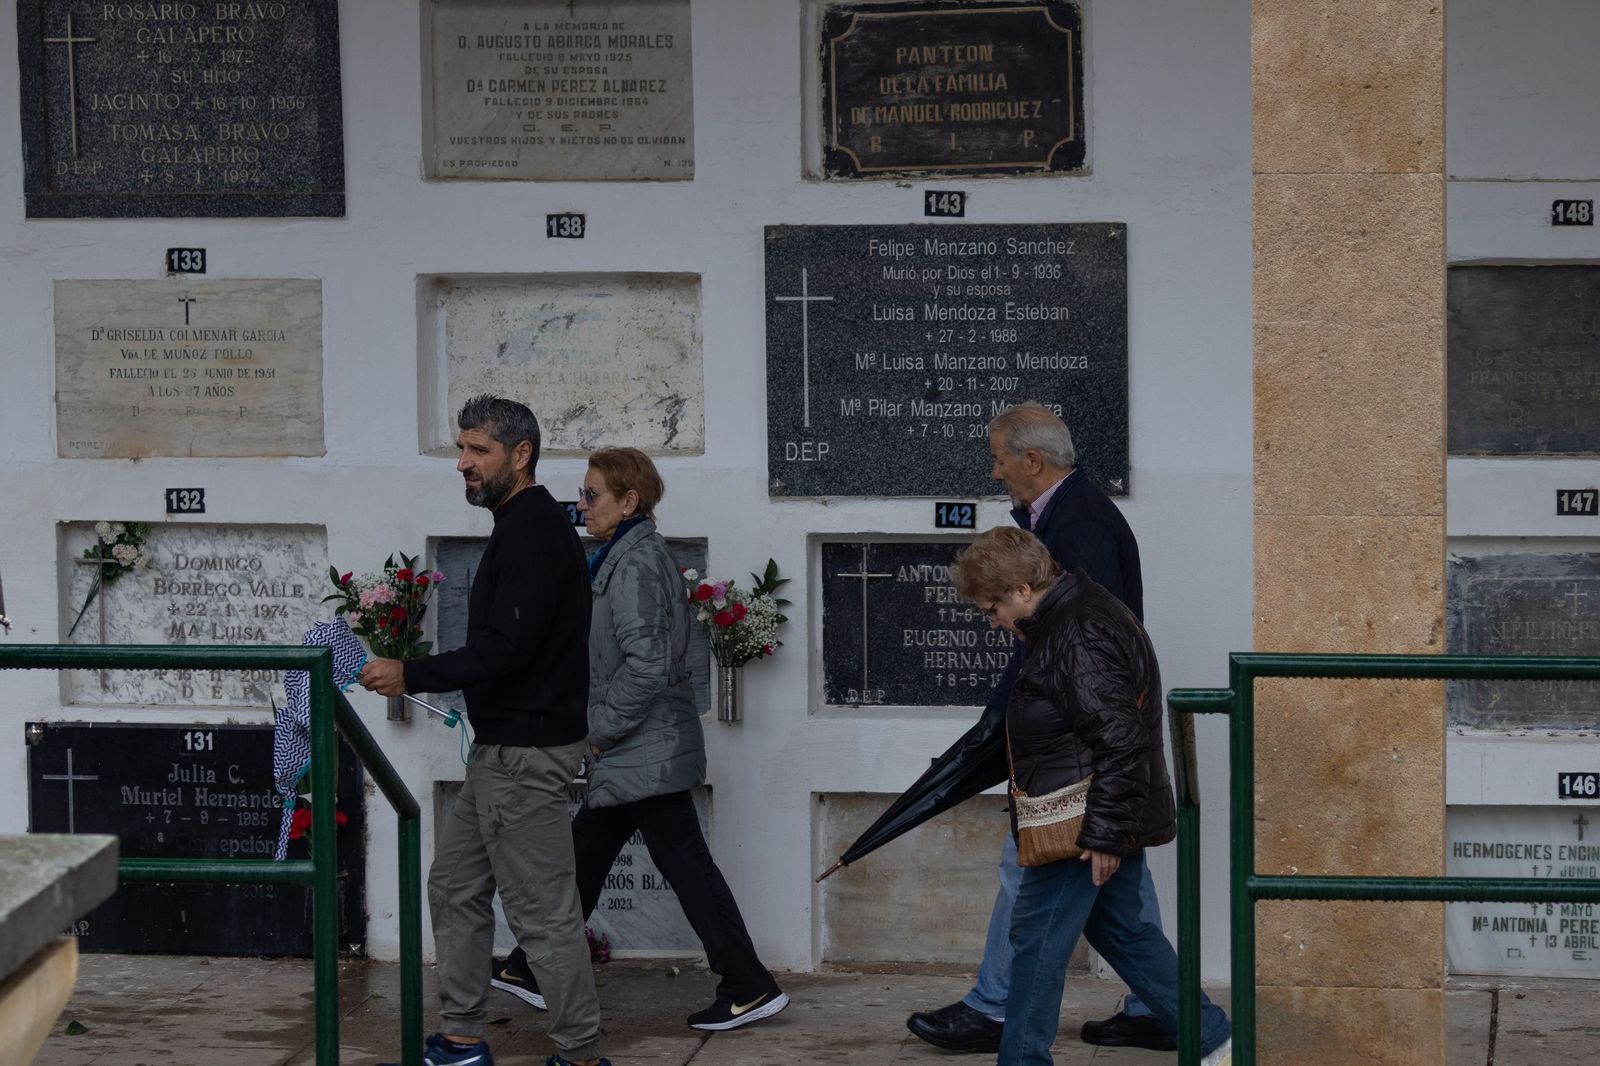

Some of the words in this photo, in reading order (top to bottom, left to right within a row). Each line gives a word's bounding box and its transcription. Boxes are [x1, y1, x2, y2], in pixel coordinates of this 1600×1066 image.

[103, 3, 196, 21] ROSARIO
[216, 3, 286, 20] BRAVO
[523, 22, 530, 31] A
[534, 22, 550, 31] LA
[554, 22, 609, 31] MEMORIA
[611, 22, 625, 31] DE
[136, 27, 255, 44] GALAPERO
[458, 35, 471, 49] D.
[477, 35, 541, 49] AUGUSTO
[548, 35, 602, 49] ABARCA
[608, 34, 674, 49] MORALES
[499, 52, 554, 62] FALLECIO
[570, 53, 601, 62] MAYO
[605, 52, 632, 62] 1925
[896, 44, 993, 65] PANTEON
[172, 70, 194, 84] SU
[203, 70, 241, 84] HIJO
[524, 66, 540, 75] DE
[544, 66, 559, 75] SU
[563, 66, 609, 75] ESPOSA
[488, 79, 546, 93] CARMEN
[552, 79, 597, 93] PEREZ
[603, 79, 667, 93] ALVAREZ
[879, 76, 903, 95] DE
[906, 75, 929, 94] LA
[934, 73, 1009, 93] FAMILIA
[91, 94, 180, 111] JACINTO
[484, 97, 541, 106] FALLECIO
[545, 97, 553, 106] 9
[557, 97, 618, 106] DICIEMBRE
[622, 97, 649, 106] 1964
[516, 110, 522, 120] Y
[528, 110, 543, 120] DE
[547, 110, 569, 120] SUS
[574, 110, 619, 120] PADRES
[875, 103, 944, 124] MANUEL
[950, 100, 1043, 122] RODRIGUEZ
[110, 124, 199, 141] TOMASA
[218, 124, 290, 141] BRAVO
[449, 136, 507, 145] VUESTROS
[511, 136, 544, 145] HIJOS
[549, 136, 555, 145] Y
[560, 136, 601, 145] NIETOS
[604, 136, 617, 145] NO
[620, 136, 634, 145] OS
[637, 136, 686, 145] OLVIDAN
[140, 147, 260, 164] GALAPERO
[459, 159, 518, 168] PROPIEDAD
[928, 193, 961, 214] 143
[1556, 202, 1590, 222] 148
[549, 217, 582, 236] 138
[868, 239, 915, 260] Felipe
[925, 238, 997, 256] Manzano
[1007, 237, 1075, 255] Sanchez
[170, 251, 202, 271] 133
[882, 264, 917, 280] Murió
[922, 268, 941, 282] por
[948, 265, 975, 280] Dios
[1033, 264, 1061, 279] 1936
[932, 285, 940, 298] y
[946, 285, 961, 296] su
[966, 284, 1012, 299] esposa
[873, 304, 914, 321] Luisa
[924, 304, 997, 321] Mendoza
[1005, 302, 1069, 321] Esteban
[107, 329, 164, 342] GRISELDA
[169, 329, 237, 342] COLMENAR
[242, 329, 286, 342] GARCIA
[938, 329, 954, 343] 27
[990, 329, 1017, 343] 1988
[143, 349, 157, 360] DE
[163, 344, 207, 360] MUÑOZ
[214, 349, 253, 360] POLLO
[855, 353, 876, 370] Mª
[882, 353, 924, 370] Luisa
[934, 353, 1006, 370] Manzano
[1016, 352, 1088, 369] Mendoza
[109, 367, 159, 379] FALLECIO
[163, 368, 177, 379] EL
[202, 367, 233, 379] JUNIO
[237, 367, 251, 379] DE
[254, 369, 276, 379] 1951
[204, 382, 235, 397] AÑOS
[938, 377, 953, 391] 20
[990, 377, 1019, 391] 2007
[840, 399, 862, 417] Mª
[868, 399, 902, 417] Pilar
[910, 399, 982, 417] Manzano
[169, 491, 202, 510] 132
[1561, 493, 1594, 512] 147
[938, 505, 972, 526] 142
[174, 553, 262, 572] DOMINGO
[152, 577, 241, 597] BORREGO
[248, 581, 305, 599] VALLE
[185, 604, 207, 616] 22
[254, 604, 289, 619] 1974
[903, 630, 977, 647] EUGENIO
[924, 652, 1013, 669] HERNAND
[184, 731, 213, 751] 131
[168, 763, 217, 784] Julia
[228, 766, 245, 784] C.
[1562, 775, 1596, 795] 146
[120, 785, 183, 806] Muriel
[194, 786, 283, 810] Hernánde
[237, 812, 269, 827] 1985
[1453, 842, 1552, 861] HERMOGENES
[1560, 865, 1597, 878] JUNIO
[642, 874, 672, 890] BLA
[607, 897, 633, 911] 2023
[1560, 904, 1593, 917] MAYO
[1492, 918, 1548, 933] ANTONIA
[1564, 935, 1599, 949] ABRIL
